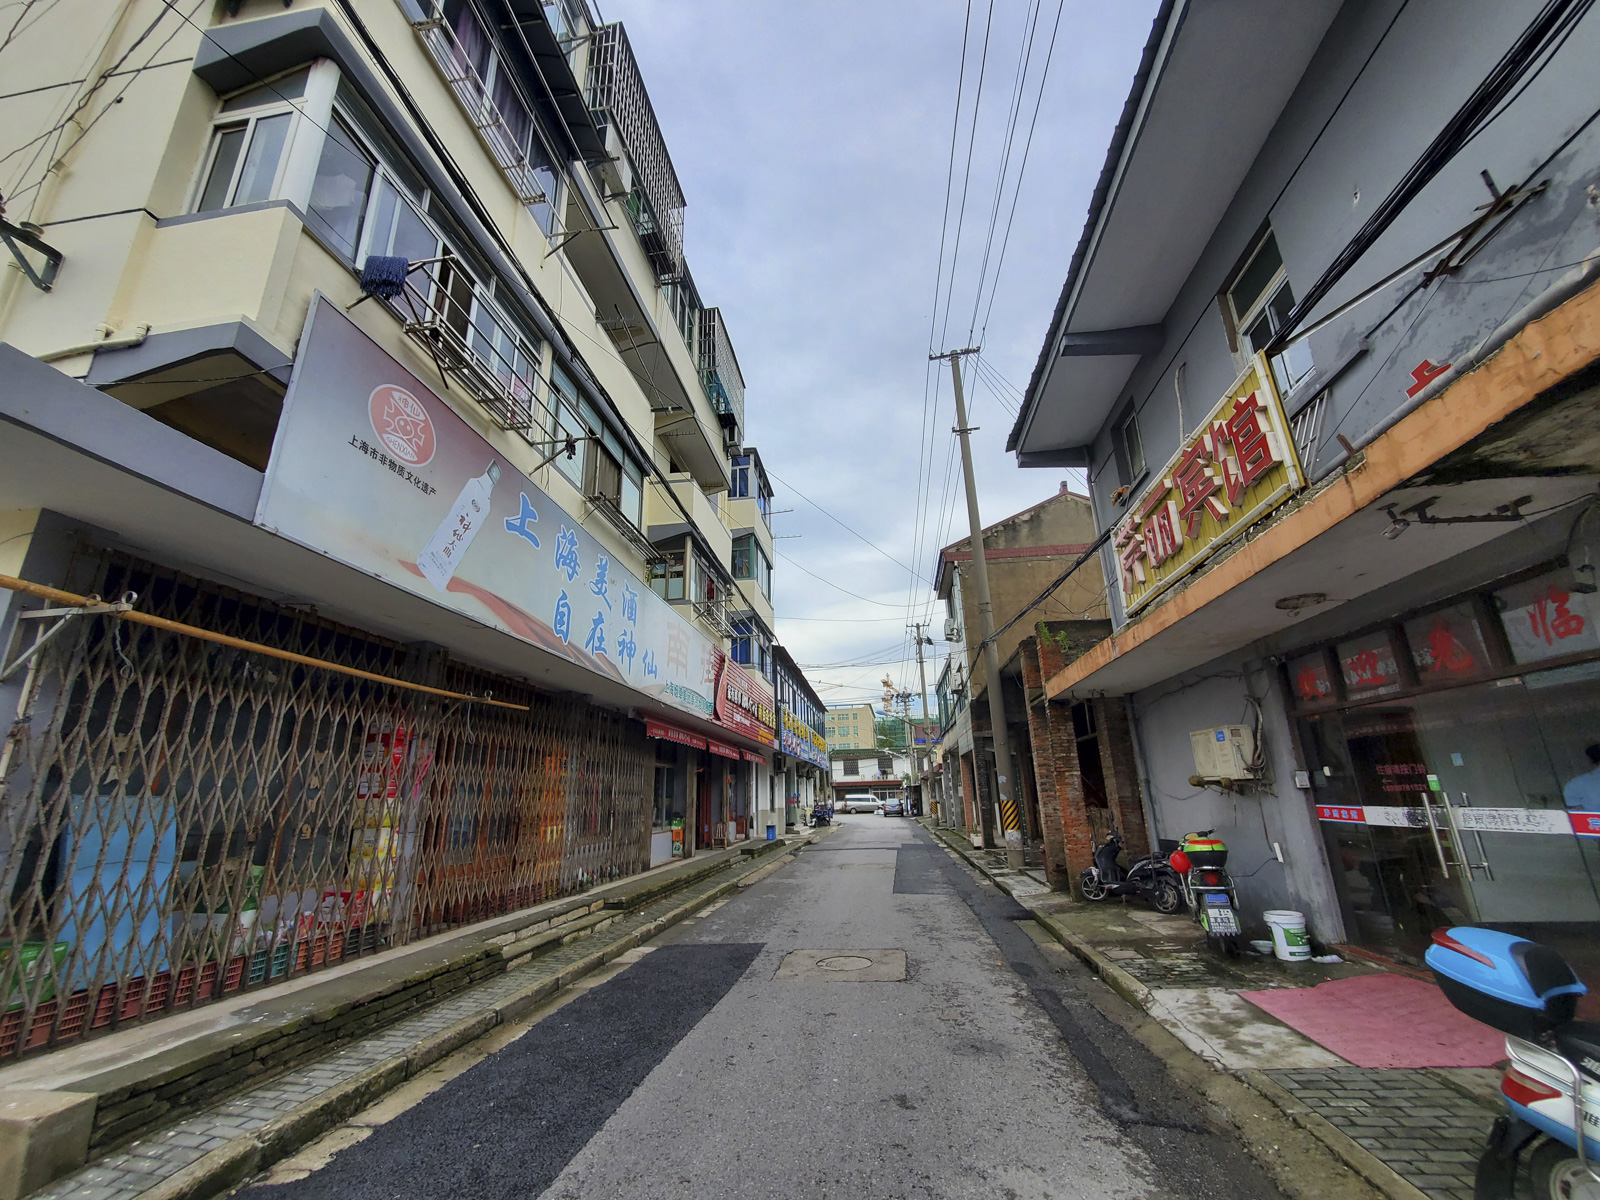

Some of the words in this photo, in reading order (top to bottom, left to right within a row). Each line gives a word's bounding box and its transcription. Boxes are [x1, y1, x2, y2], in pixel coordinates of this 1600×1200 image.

[397, 394, 421, 417] 神仙
[348, 434, 437, 496] 上海市非物质文化遗产
[504, 492, 638, 628] 上海美酒
[553, 589, 658, 680] 自在神仙
